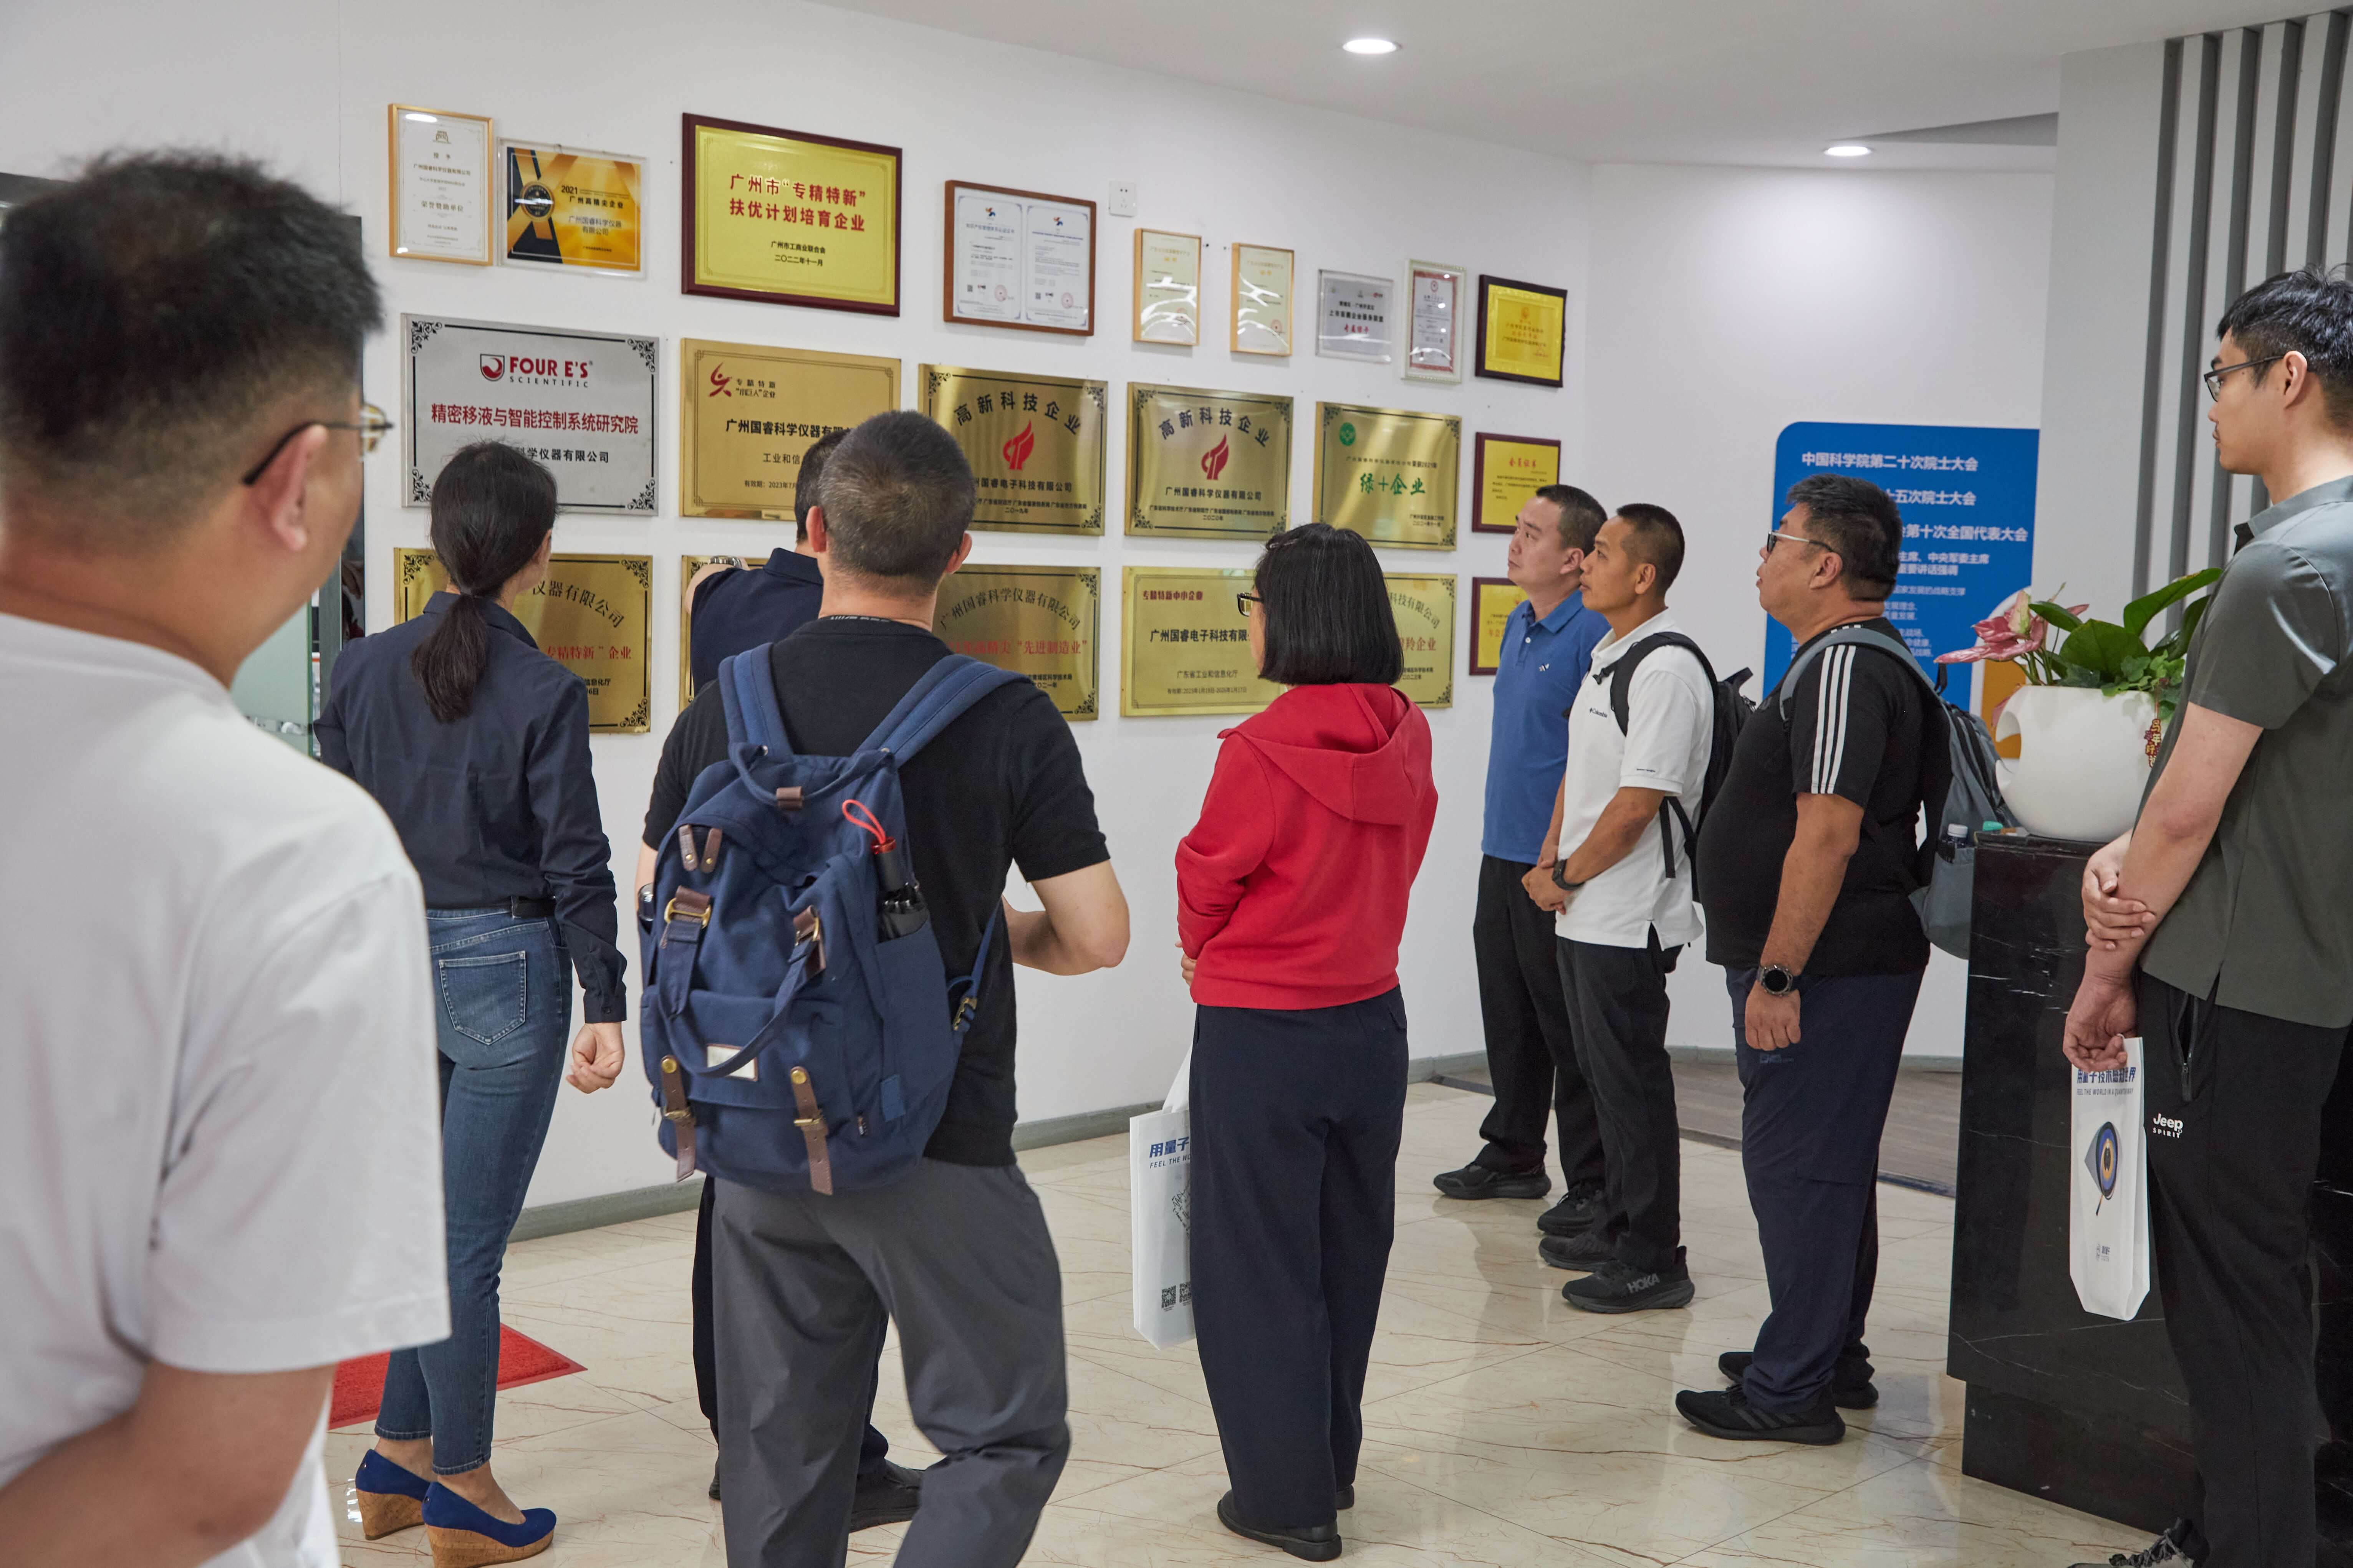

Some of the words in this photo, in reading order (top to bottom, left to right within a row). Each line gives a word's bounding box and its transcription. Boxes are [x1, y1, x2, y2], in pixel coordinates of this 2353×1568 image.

[561, 185, 578, 194] 2021
[569, 215, 622, 228] 广州国睿科学仪器
[730, 197, 865, 232] 扶优计划培育企业
[583, 226, 609, 236] 有限公司
[771, 240, 826, 254] 广州市工商业联合会
[510, 356, 558, 377] FOUR
[510, 376, 588, 388] SCIENTIFIC
[431, 403, 639, 434] 精密移液与智能控制系统研究院
[954, 391, 1081, 435] 高新科技企业
[1159, 407, 1269, 447] 高新科技企业
[1802, 452, 1978, 472] 中国科学院第二十次院士大会
[1165, 487, 1262, 501] 广州国睿科学仪器有限公司
[1902, 523, 2028, 542] 第十次全国代表大会
[1143, 590, 1203, 600] 专精特新中小企业
[940, 587, 1081, 630] 广州国睿科学仪器有限公司
[2153, 1113, 2183, 1132] Jeep
[2153, 1127, 2181, 1138] SPIRIT
[1150, 1160, 1166, 1169] FEEL
[1169, 1156, 1181, 1165] THE
[1627, 1273, 1661, 1293] HOKA
